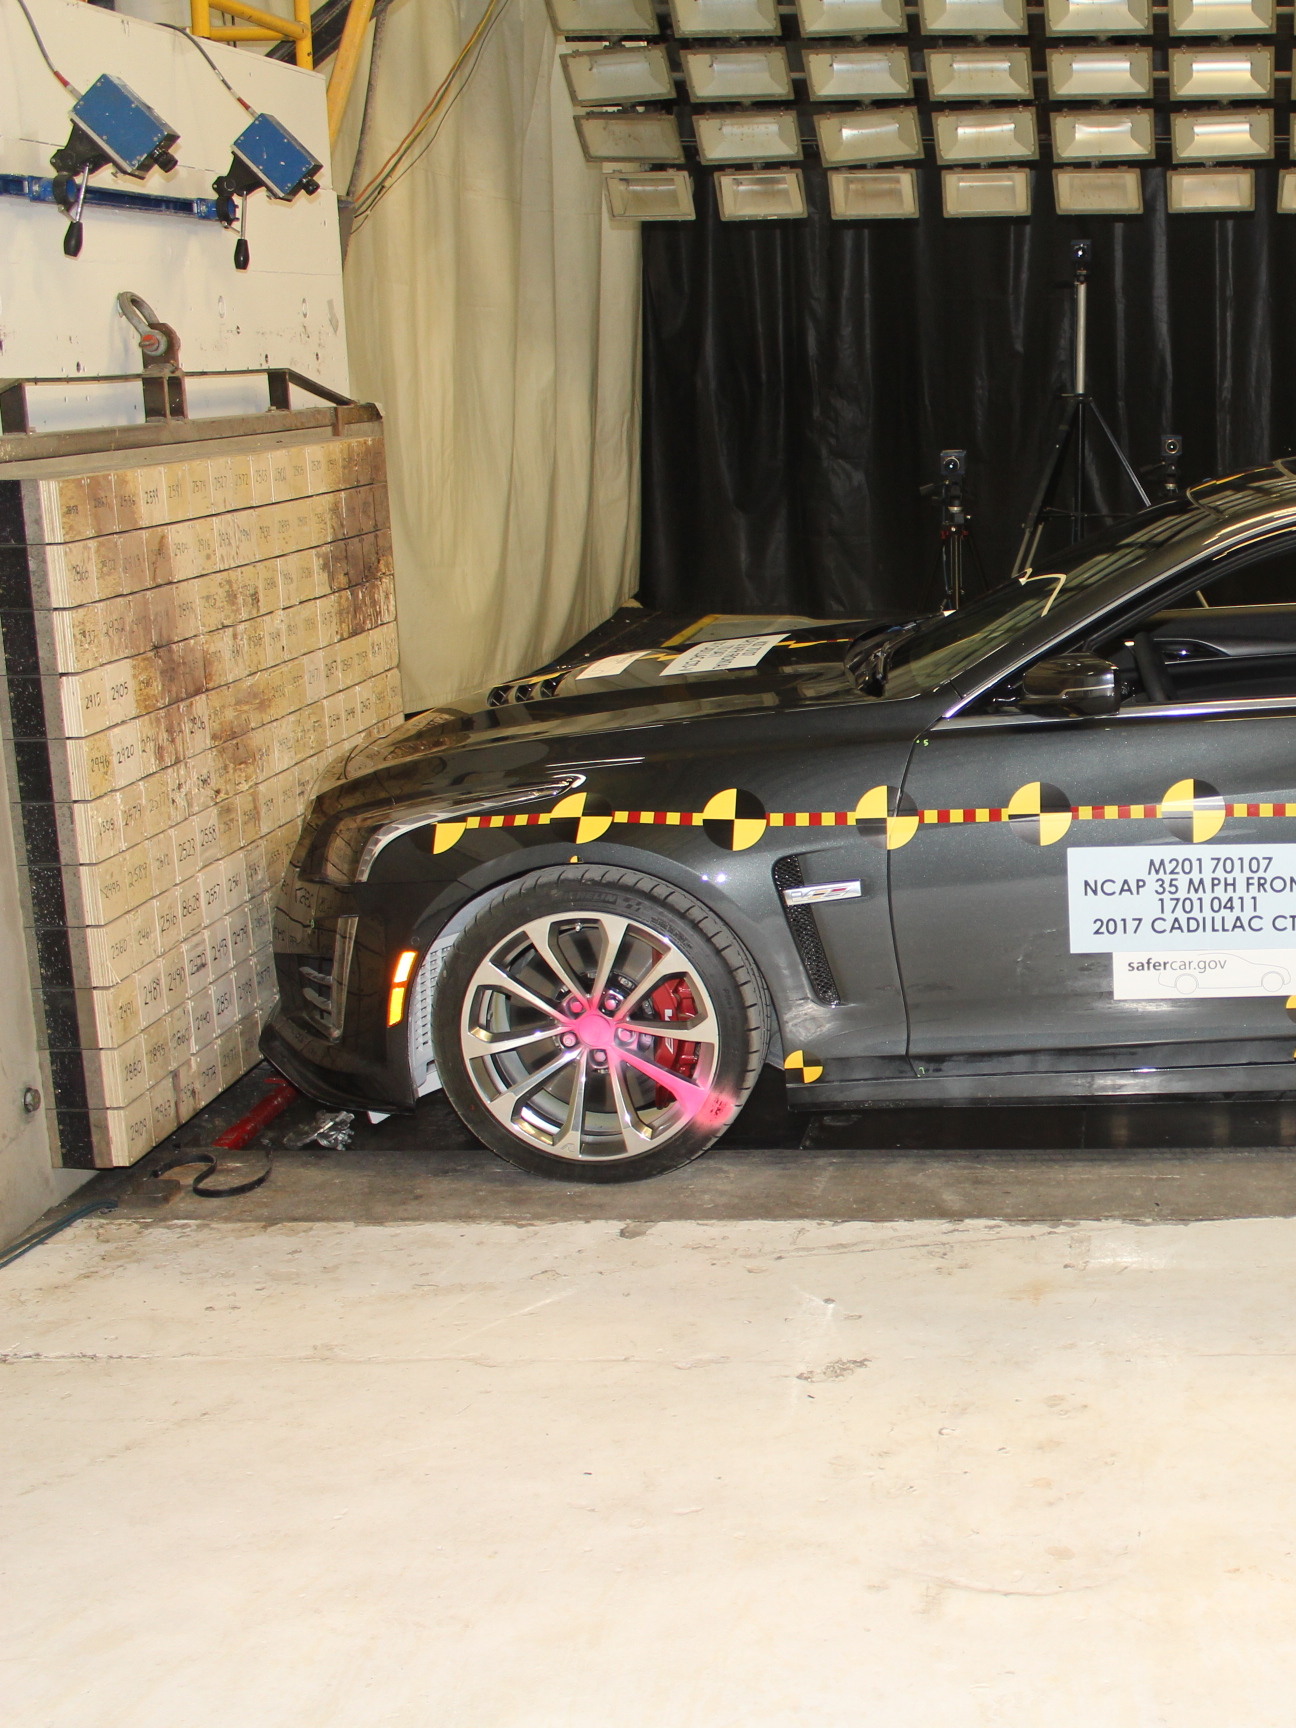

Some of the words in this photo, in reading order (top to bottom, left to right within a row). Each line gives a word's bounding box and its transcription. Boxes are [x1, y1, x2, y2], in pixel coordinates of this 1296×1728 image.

[307, 666, 321, 686] 2471
[84, 690, 102, 711] 2915
[110, 680, 129, 702] 2905
[115, 742, 135, 765] 2920
[923, 738, 929, 747] 5
[90, 751, 110, 775] 2946
[199, 822, 218, 848] 2558
[177, 835, 196, 864] 2523
[1147, 856, 1274, 876] M20170107
[205, 881, 221, 906] 2557
[1083, 878, 1147, 897] NCAP
[1154, 877, 1179, 896] 35
[1186, 876, 1237, 895] MPH
[181, 891, 201, 919] 8628
[1157, 896, 1259, 915] 17010411
[159, 907, 178, 933] 2516
[1092, 917, 1143, 936] 2017
[1151, 915, 1264, 934] CADILLAC
[1127, 957, 1227, 974] safercar.gov
[166, 962, 186, 993] 2490
[215, 988, 232, 1016] 2851
